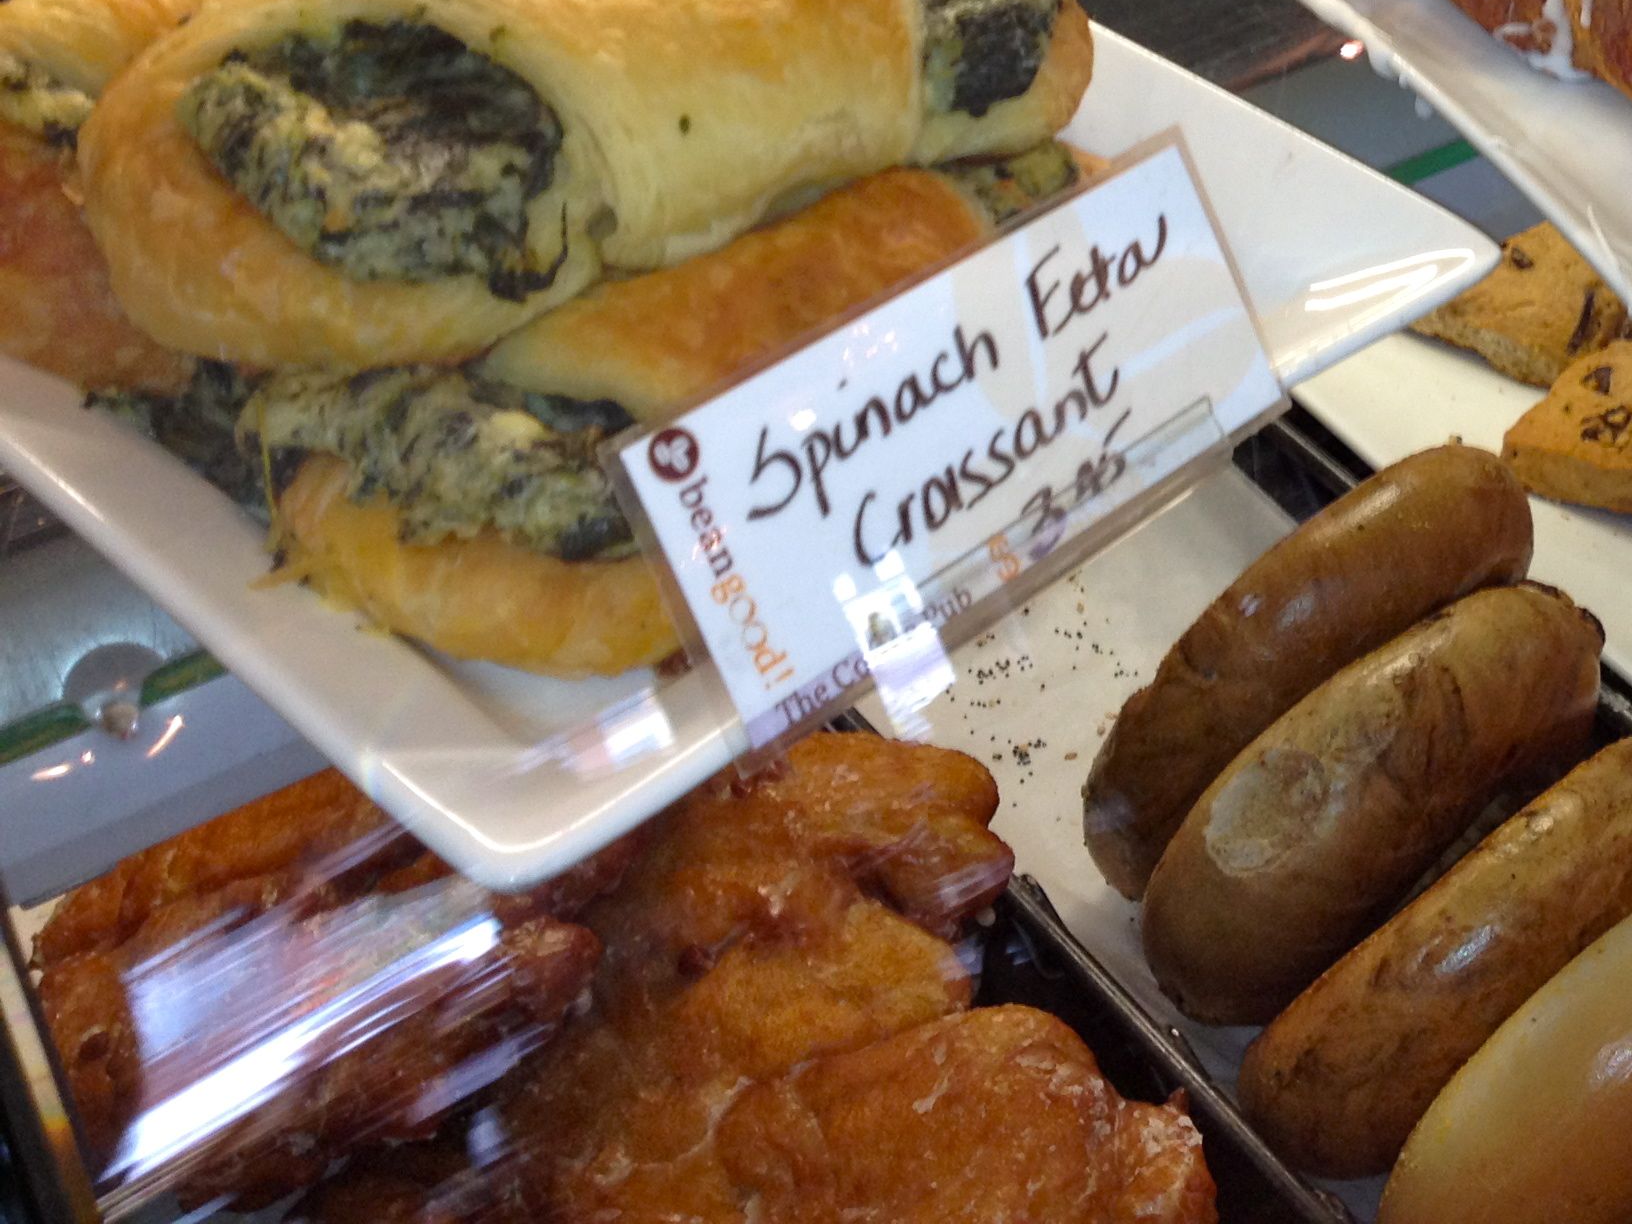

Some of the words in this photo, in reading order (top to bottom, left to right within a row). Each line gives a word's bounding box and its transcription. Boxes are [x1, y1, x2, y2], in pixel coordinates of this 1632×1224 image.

[746, 324, 999, 522] Spinach
[1025, 212, 1169, 342] Feta
[852, 332, 1120, 567] Croissant
[775, 683, 829, 726] The
